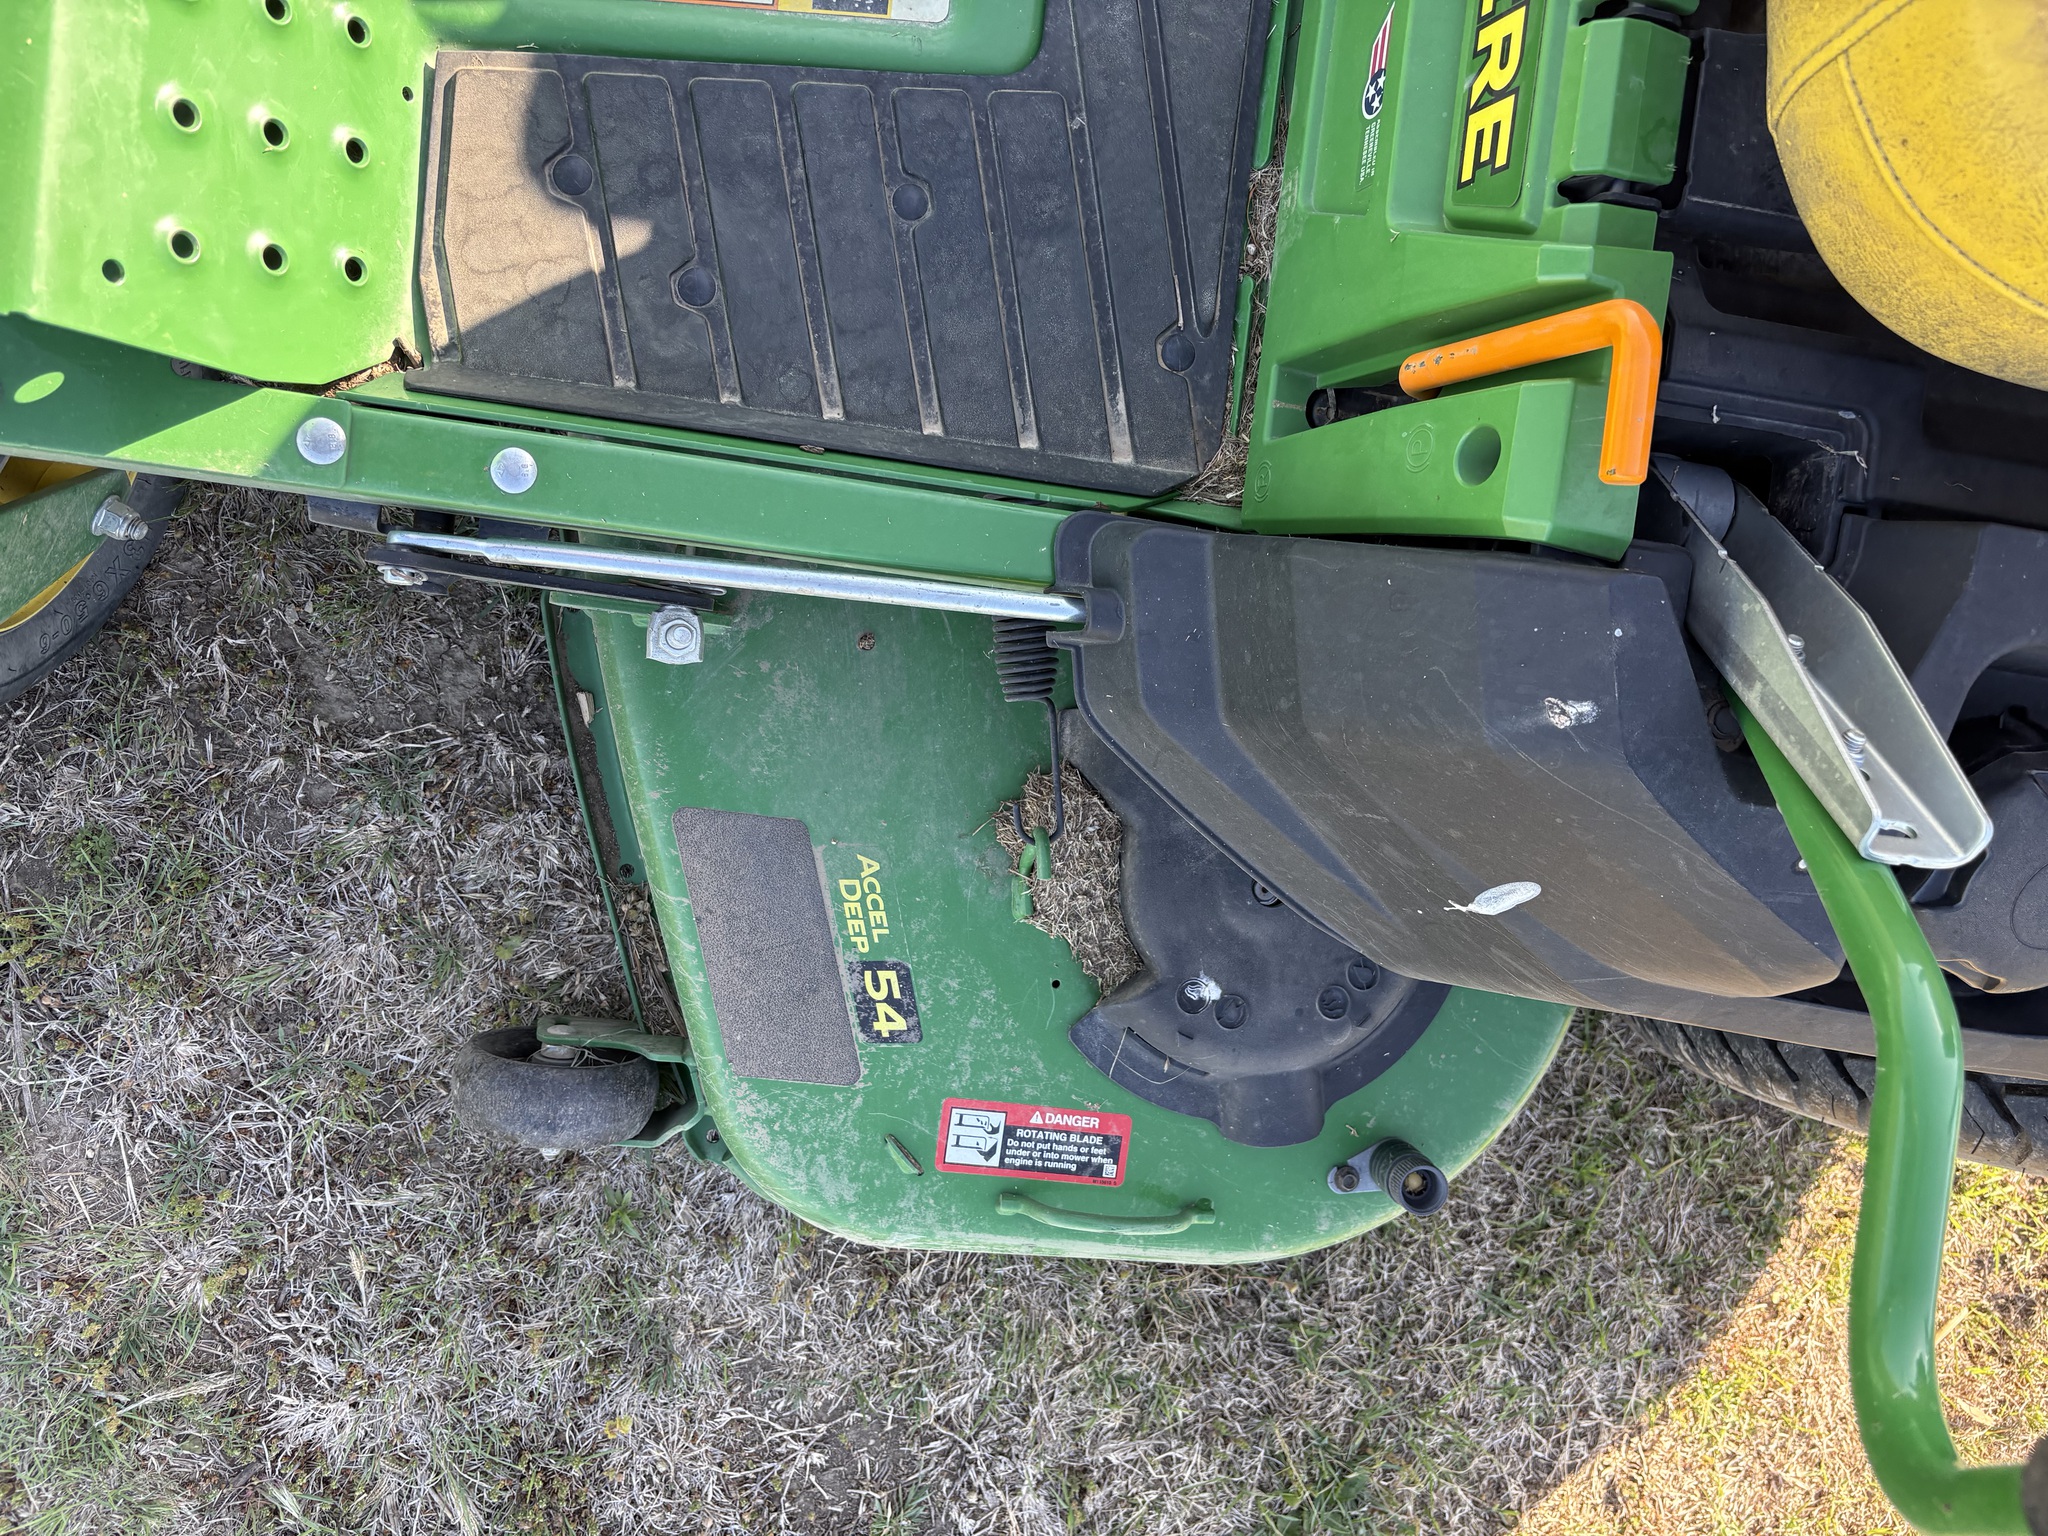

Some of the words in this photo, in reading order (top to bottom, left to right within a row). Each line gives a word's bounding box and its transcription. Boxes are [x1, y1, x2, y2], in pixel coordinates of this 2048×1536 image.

[1459, 0, 1528, 186] RE
[856, 854, 890, 943] ACCEL
[838, 879, 870, 954] DEEP
[863, 970, 908, 1038] 54
[1045, 1112, 1100, 1129] DANGER
[1016, 1128, 1067, 1142] ROTATING
[1069, 1133, 1103, 1145] BLADE
[1007, 1138, 1019, 1147] Do
[1021, 1140, 1035, 1149] not
[1036, 1142, 1051, 1151] put
[1052, 1142, 1078, 1153] hands
[1091, 1146, 1107, 1156] feet
[1004, 1157, 1033, 1167] engine
[1034, 1159, 1043, 1167] is
[1044, 1160, 1077, 1172] running
[1005, 1148, 1030, 1157] under
[1032, 1150, 1041, 1158] or
[1043, 1150, 1060, 1159] into
[1061, 1153, 1089, 1163] mower
[1091, 1156, 1113, 1165] when
